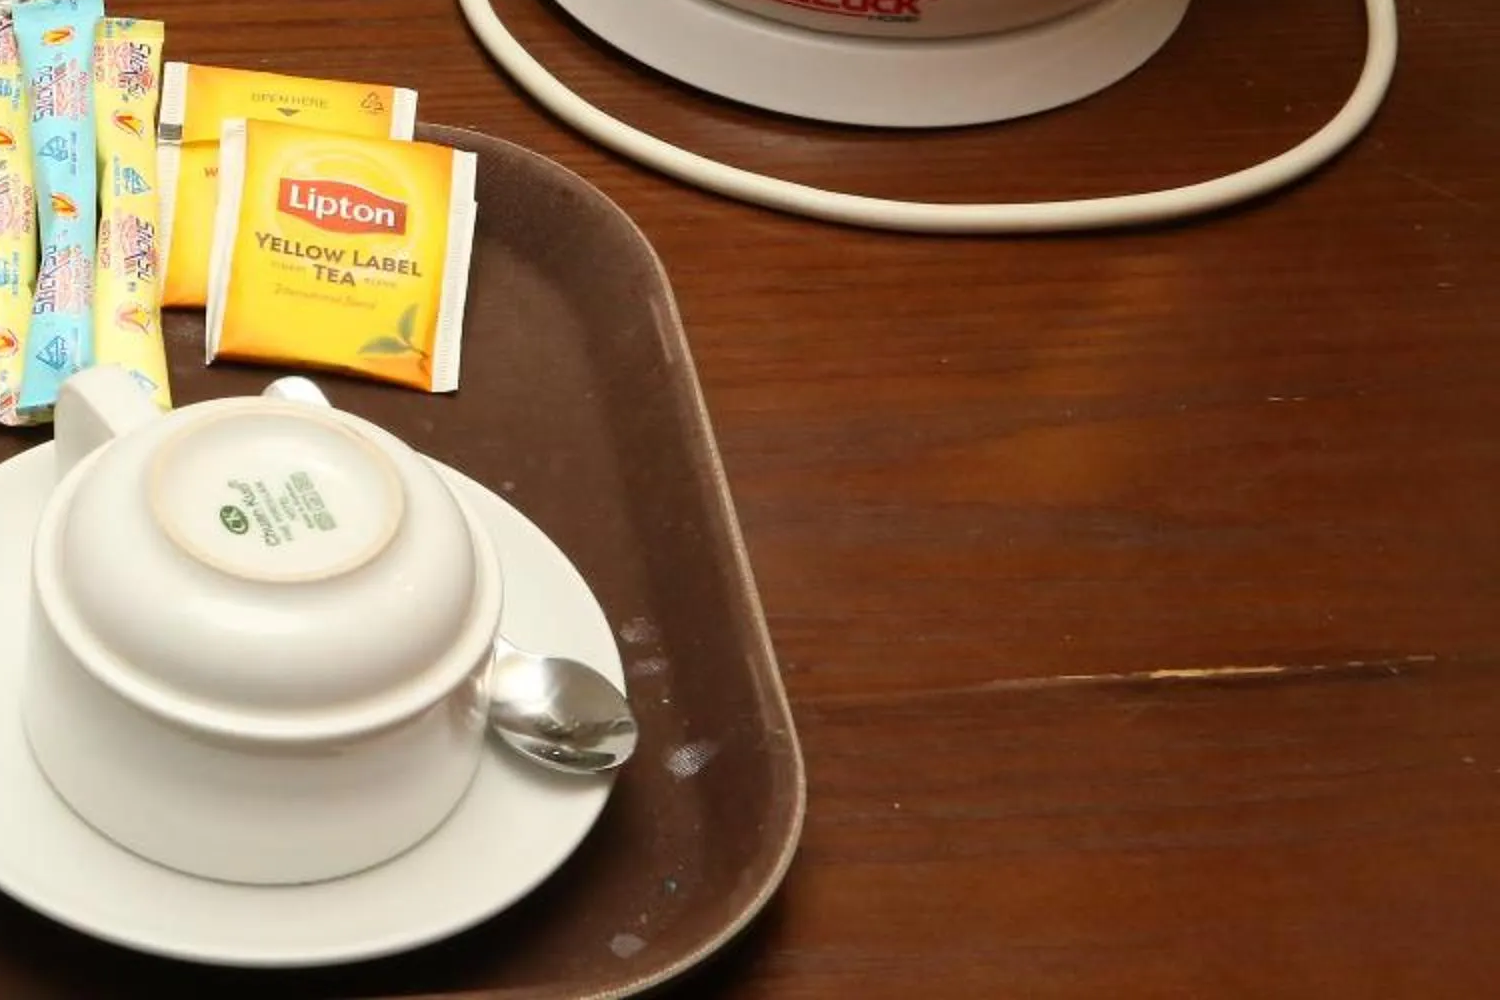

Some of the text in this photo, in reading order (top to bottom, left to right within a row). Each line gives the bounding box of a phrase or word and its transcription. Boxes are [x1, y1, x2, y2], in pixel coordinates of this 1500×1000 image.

[251, 92, 329, 109] OPEN HERE
[289, 183, 395, 228] Lipton
[255, 230, 423, 278] YELLOW LABEL
[312, 263, 357, 287] TEA
